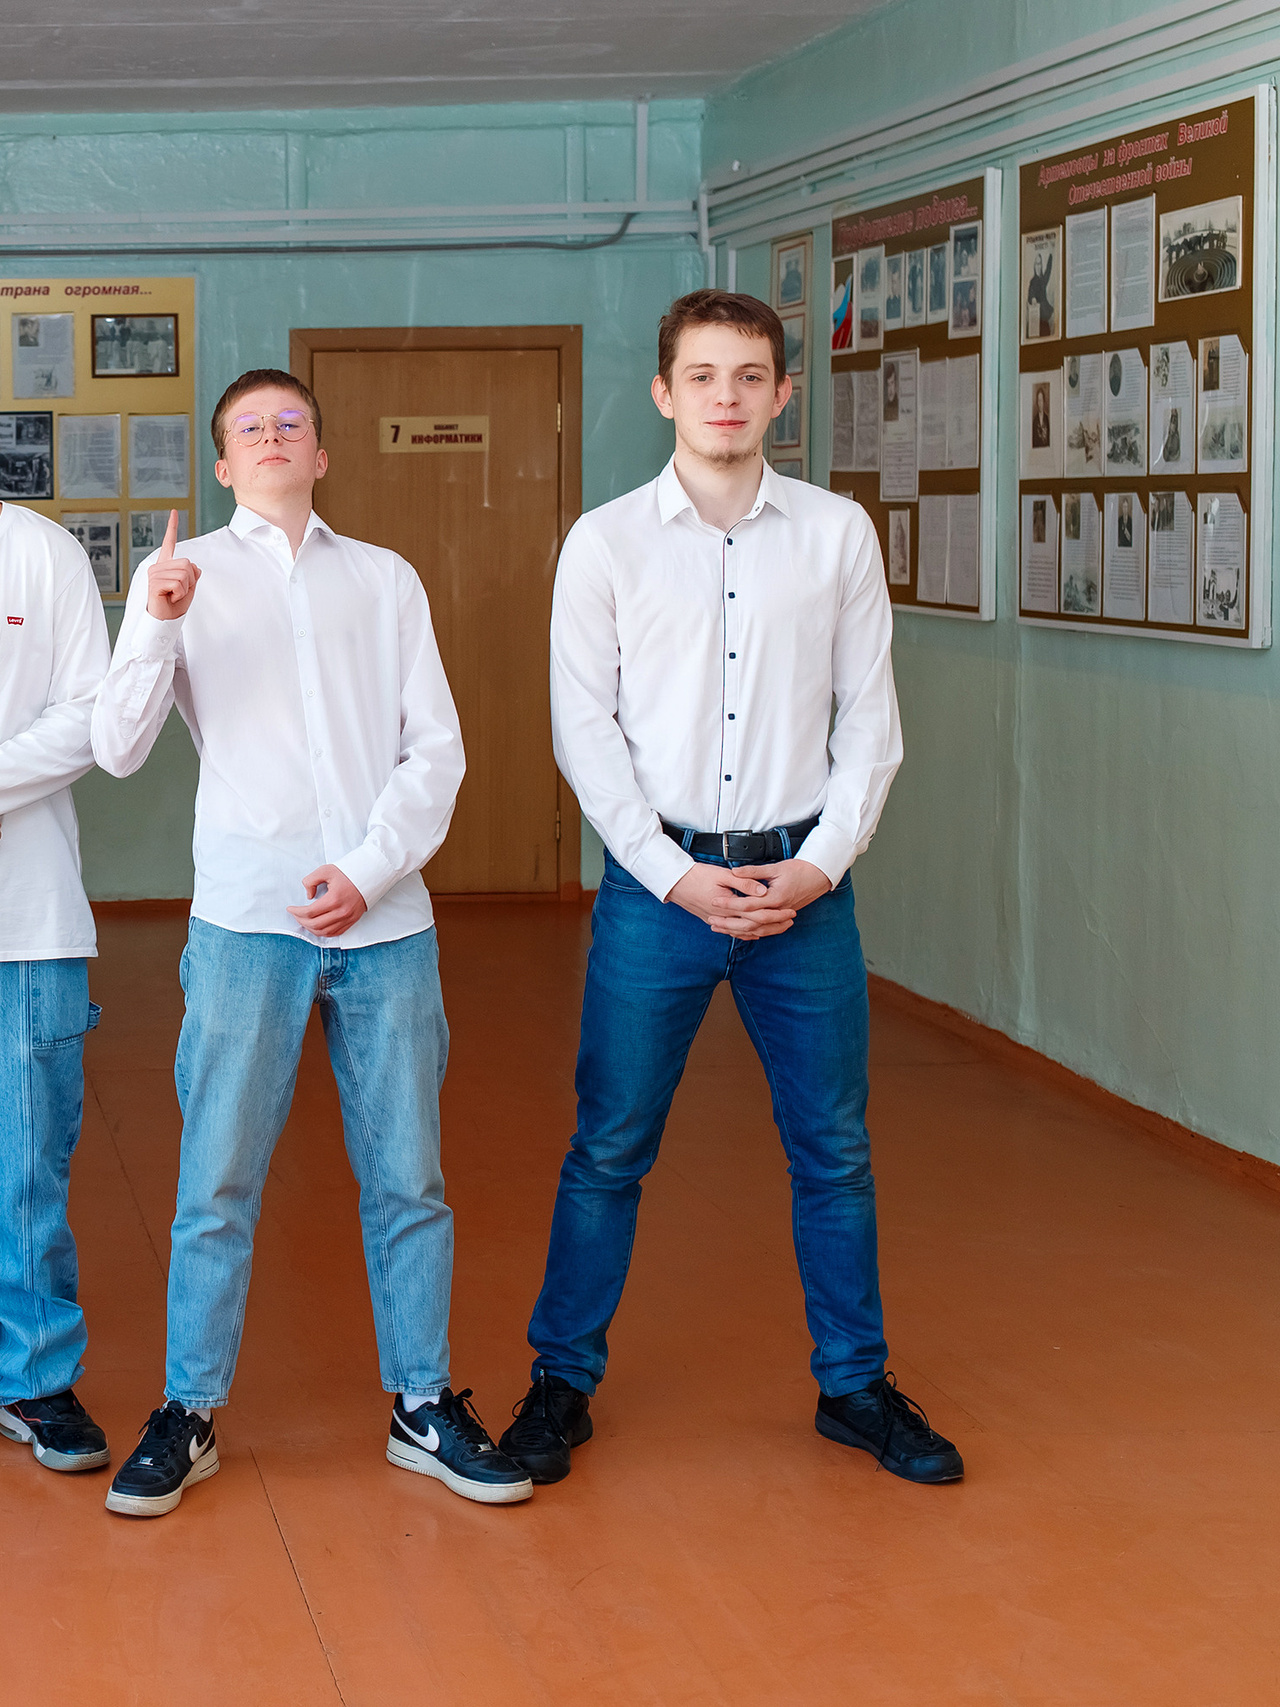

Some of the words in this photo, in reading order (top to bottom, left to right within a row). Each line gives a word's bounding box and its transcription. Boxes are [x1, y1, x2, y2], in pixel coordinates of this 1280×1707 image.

[1102, 148, 1116, 168] на
[1117, 131, 1169, 167] фронтах
[1177, 109, 1229, 147] Великой
[1068, 162, 1153, 206] Отечественной
[1154, 156, 1193, 183] войны
[64, 285, 153, 299] огромная...
[390, 424, 401, 444] 7
[411, 433, 483, 445] ИНФОРМАТИКИ
